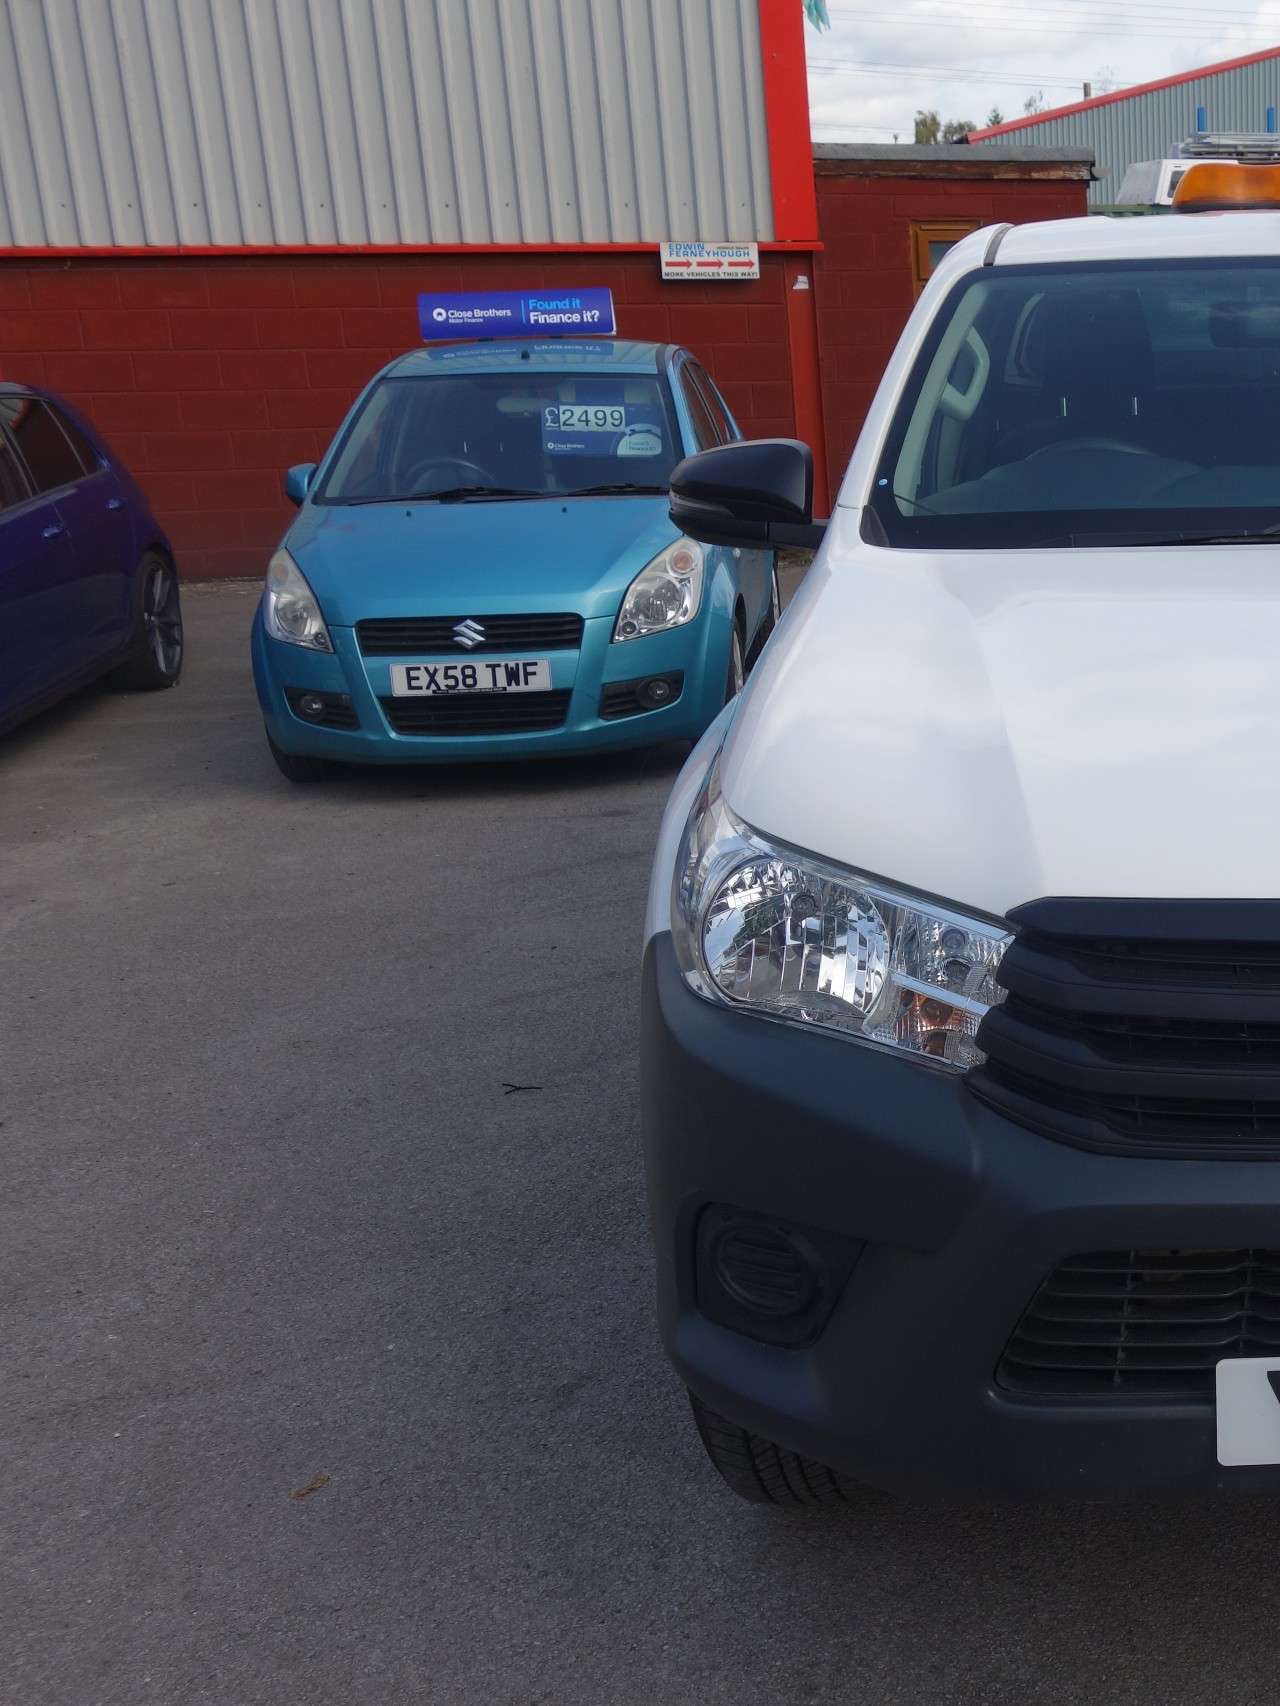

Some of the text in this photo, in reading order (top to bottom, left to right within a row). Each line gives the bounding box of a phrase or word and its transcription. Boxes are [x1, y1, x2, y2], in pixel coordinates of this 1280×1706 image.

[669, 242, 705, 250] EDWIN
[528, 297, 582, 310] Found it
[448, 308, 512, 318] Close Brothers
[529, 310, 600, 324] Finance it?
[404, 661, 539, 691] EX58 TWF
